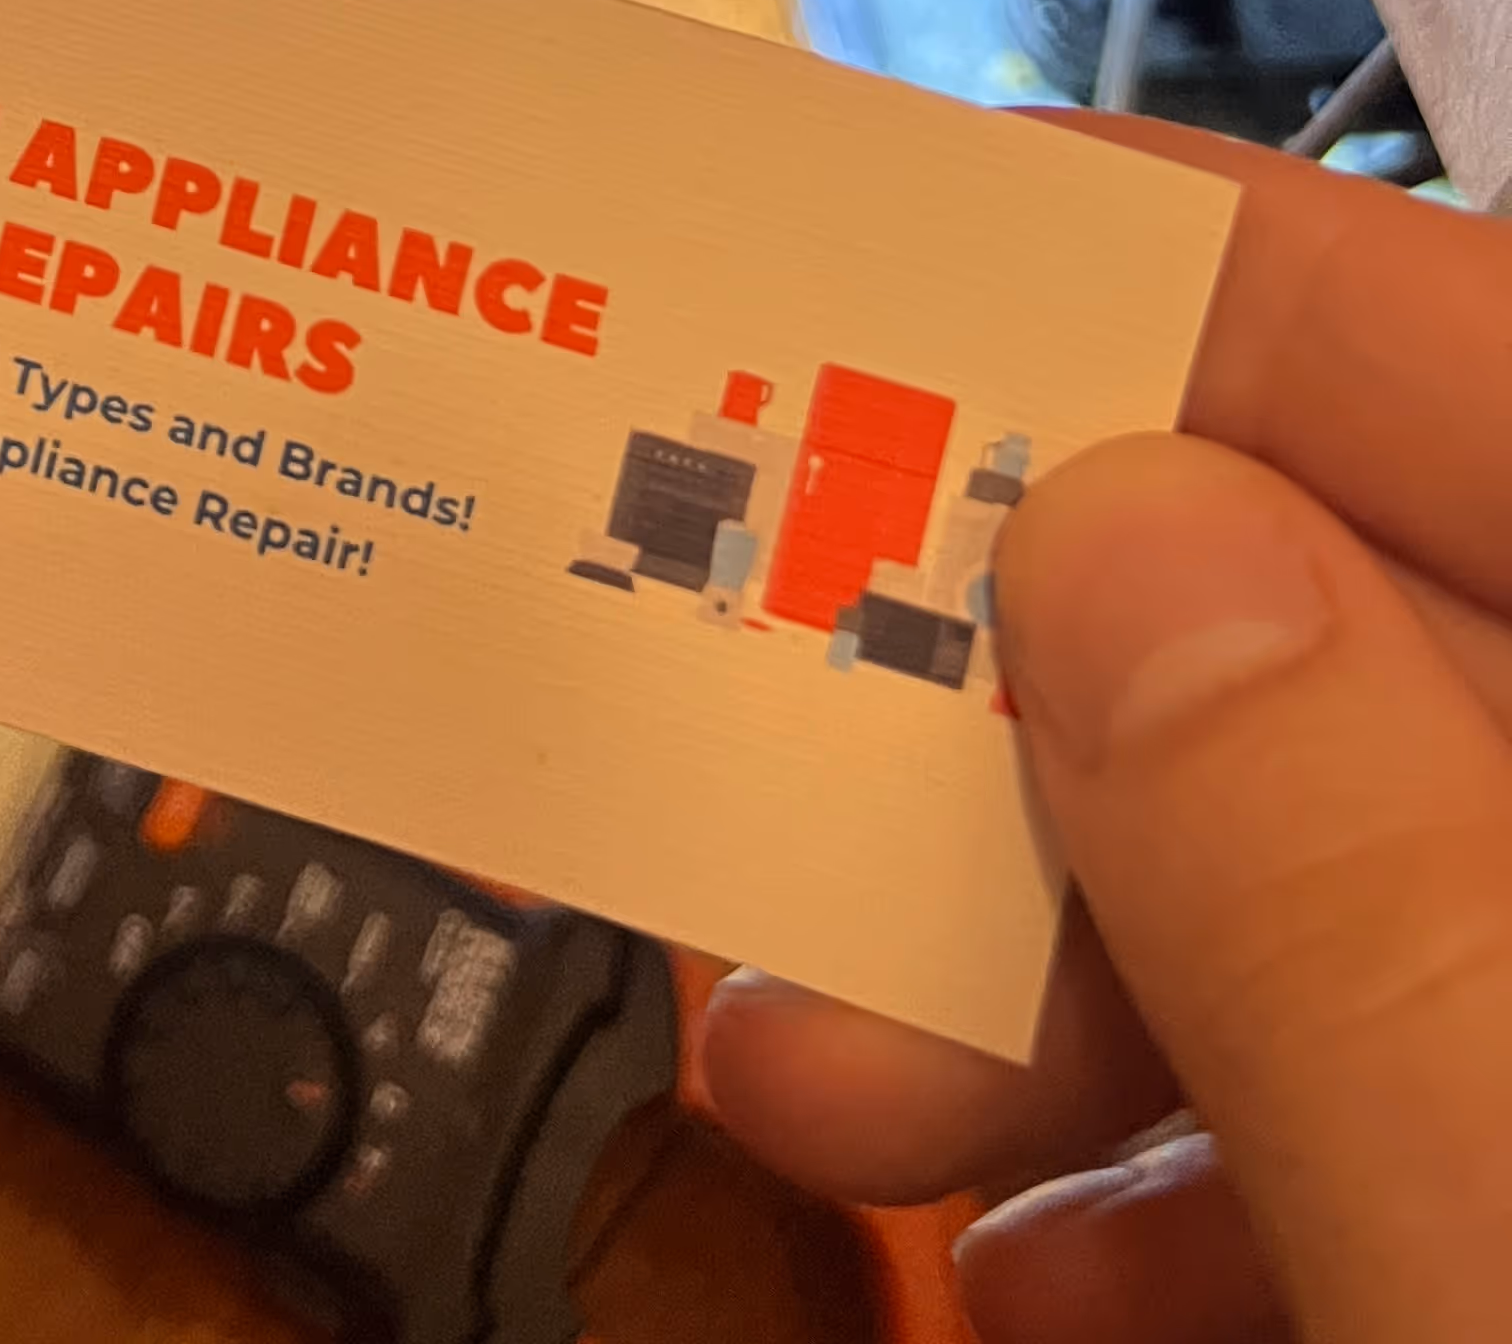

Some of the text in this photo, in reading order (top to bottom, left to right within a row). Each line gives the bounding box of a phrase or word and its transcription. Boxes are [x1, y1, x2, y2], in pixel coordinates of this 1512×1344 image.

[8, 118, 610, 358] APPLIANCE
[13, 355, 156, 434] Types
[166, 414, 267, 468] and
[277, 440, 477, 532] Brands!
[192, 489, 375, 577] Repair!
